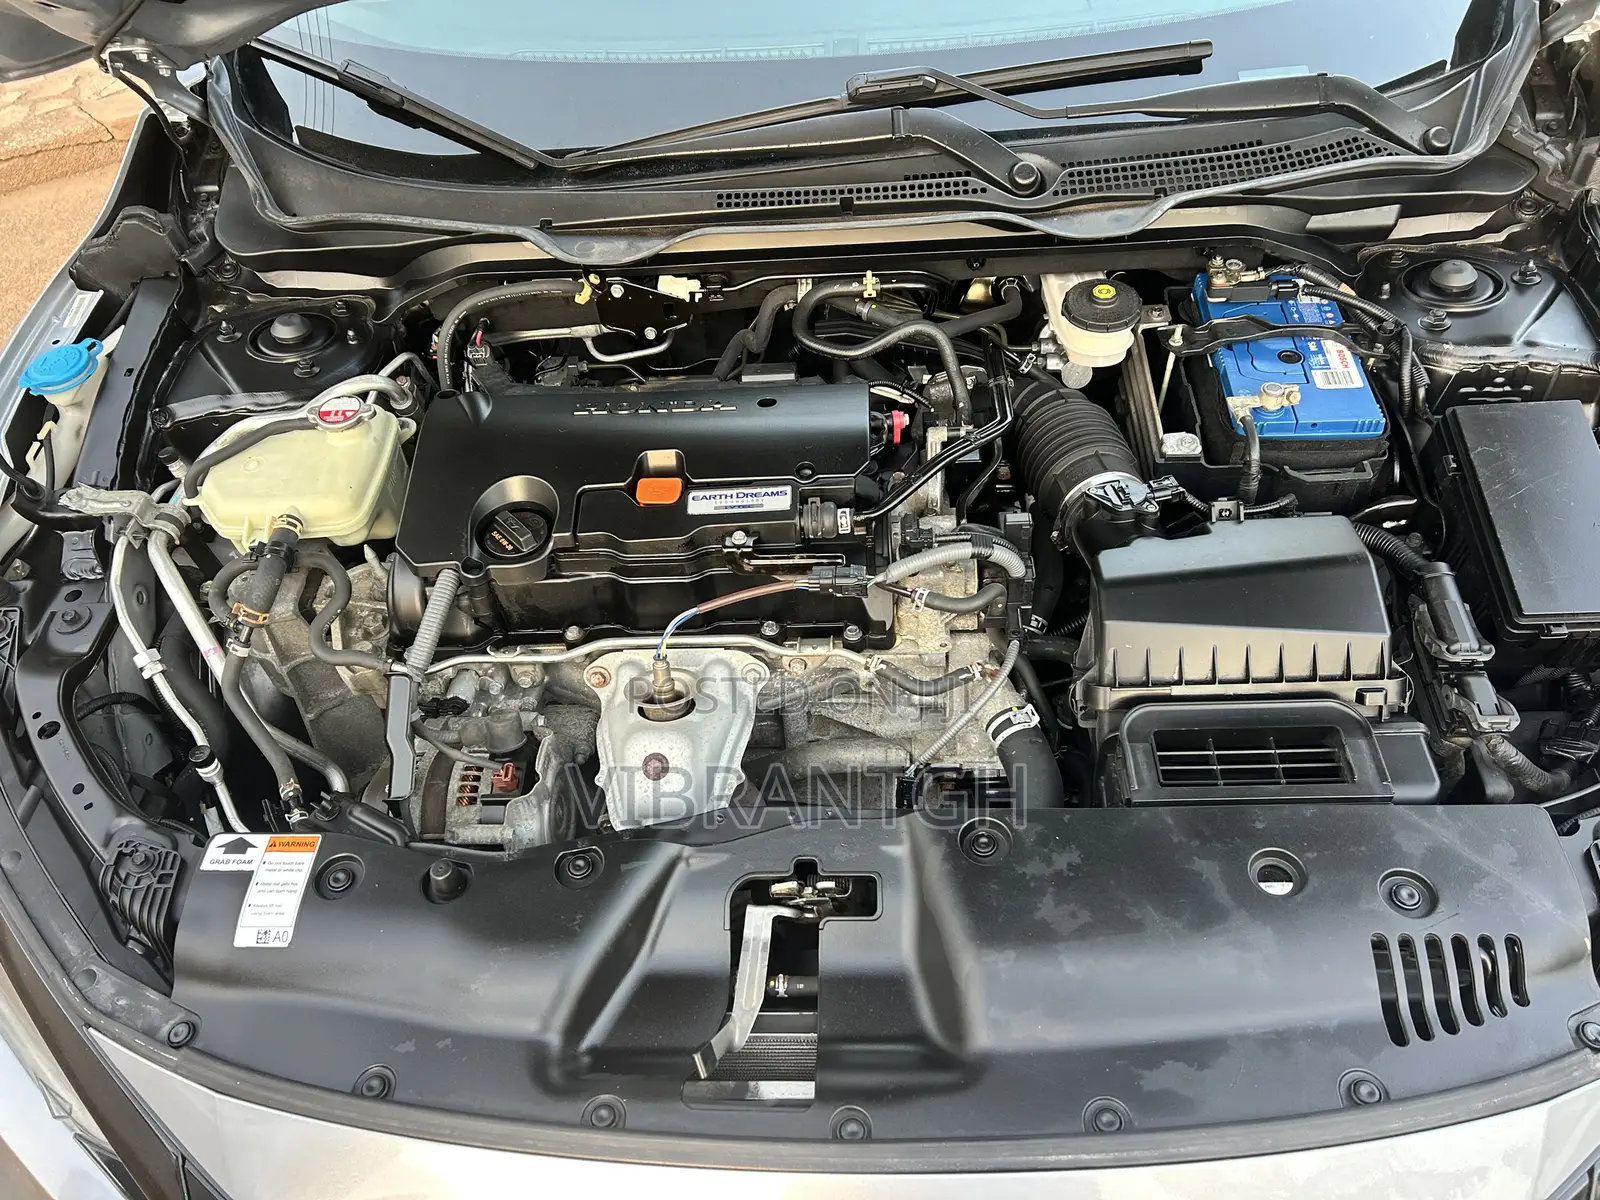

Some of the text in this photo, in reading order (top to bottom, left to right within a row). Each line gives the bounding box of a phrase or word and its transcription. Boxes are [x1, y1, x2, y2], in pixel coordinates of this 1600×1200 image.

[1336, 349, 1350, 369] BOSCH
[692, 490, 788, 502] EARTH DREAMS
[490, 530, 502, 541] SAE
[278, 840, 316, 849] WARNING
[272, 930, 289, 943] A0
